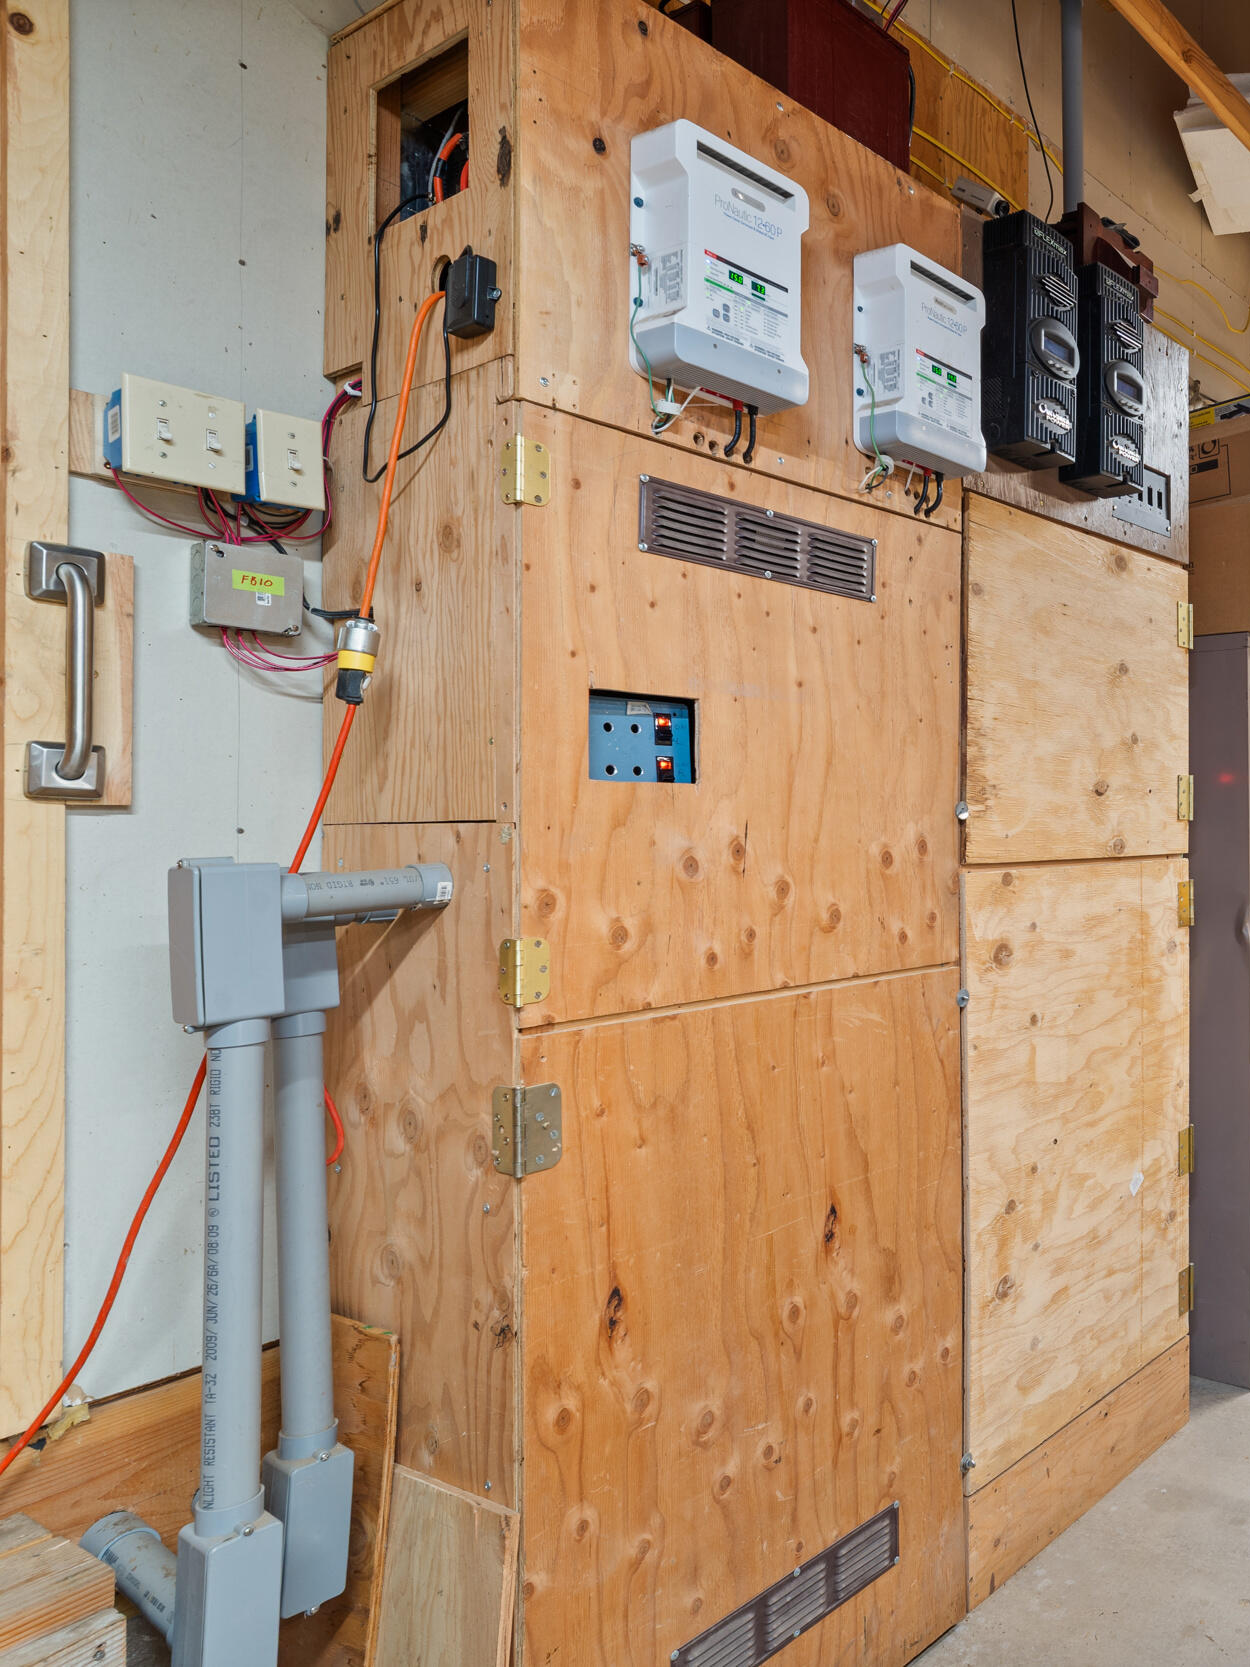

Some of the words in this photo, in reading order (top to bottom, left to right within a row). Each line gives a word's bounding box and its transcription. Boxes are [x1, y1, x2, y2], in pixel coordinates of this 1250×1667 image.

[714, 192, 752, 223] ProNautic
[210, 1069, 221, 1096] RIGID
[208, 1136, 220, 1202] LISTED
[203, 1414, 216, 1466] RESISTANT
